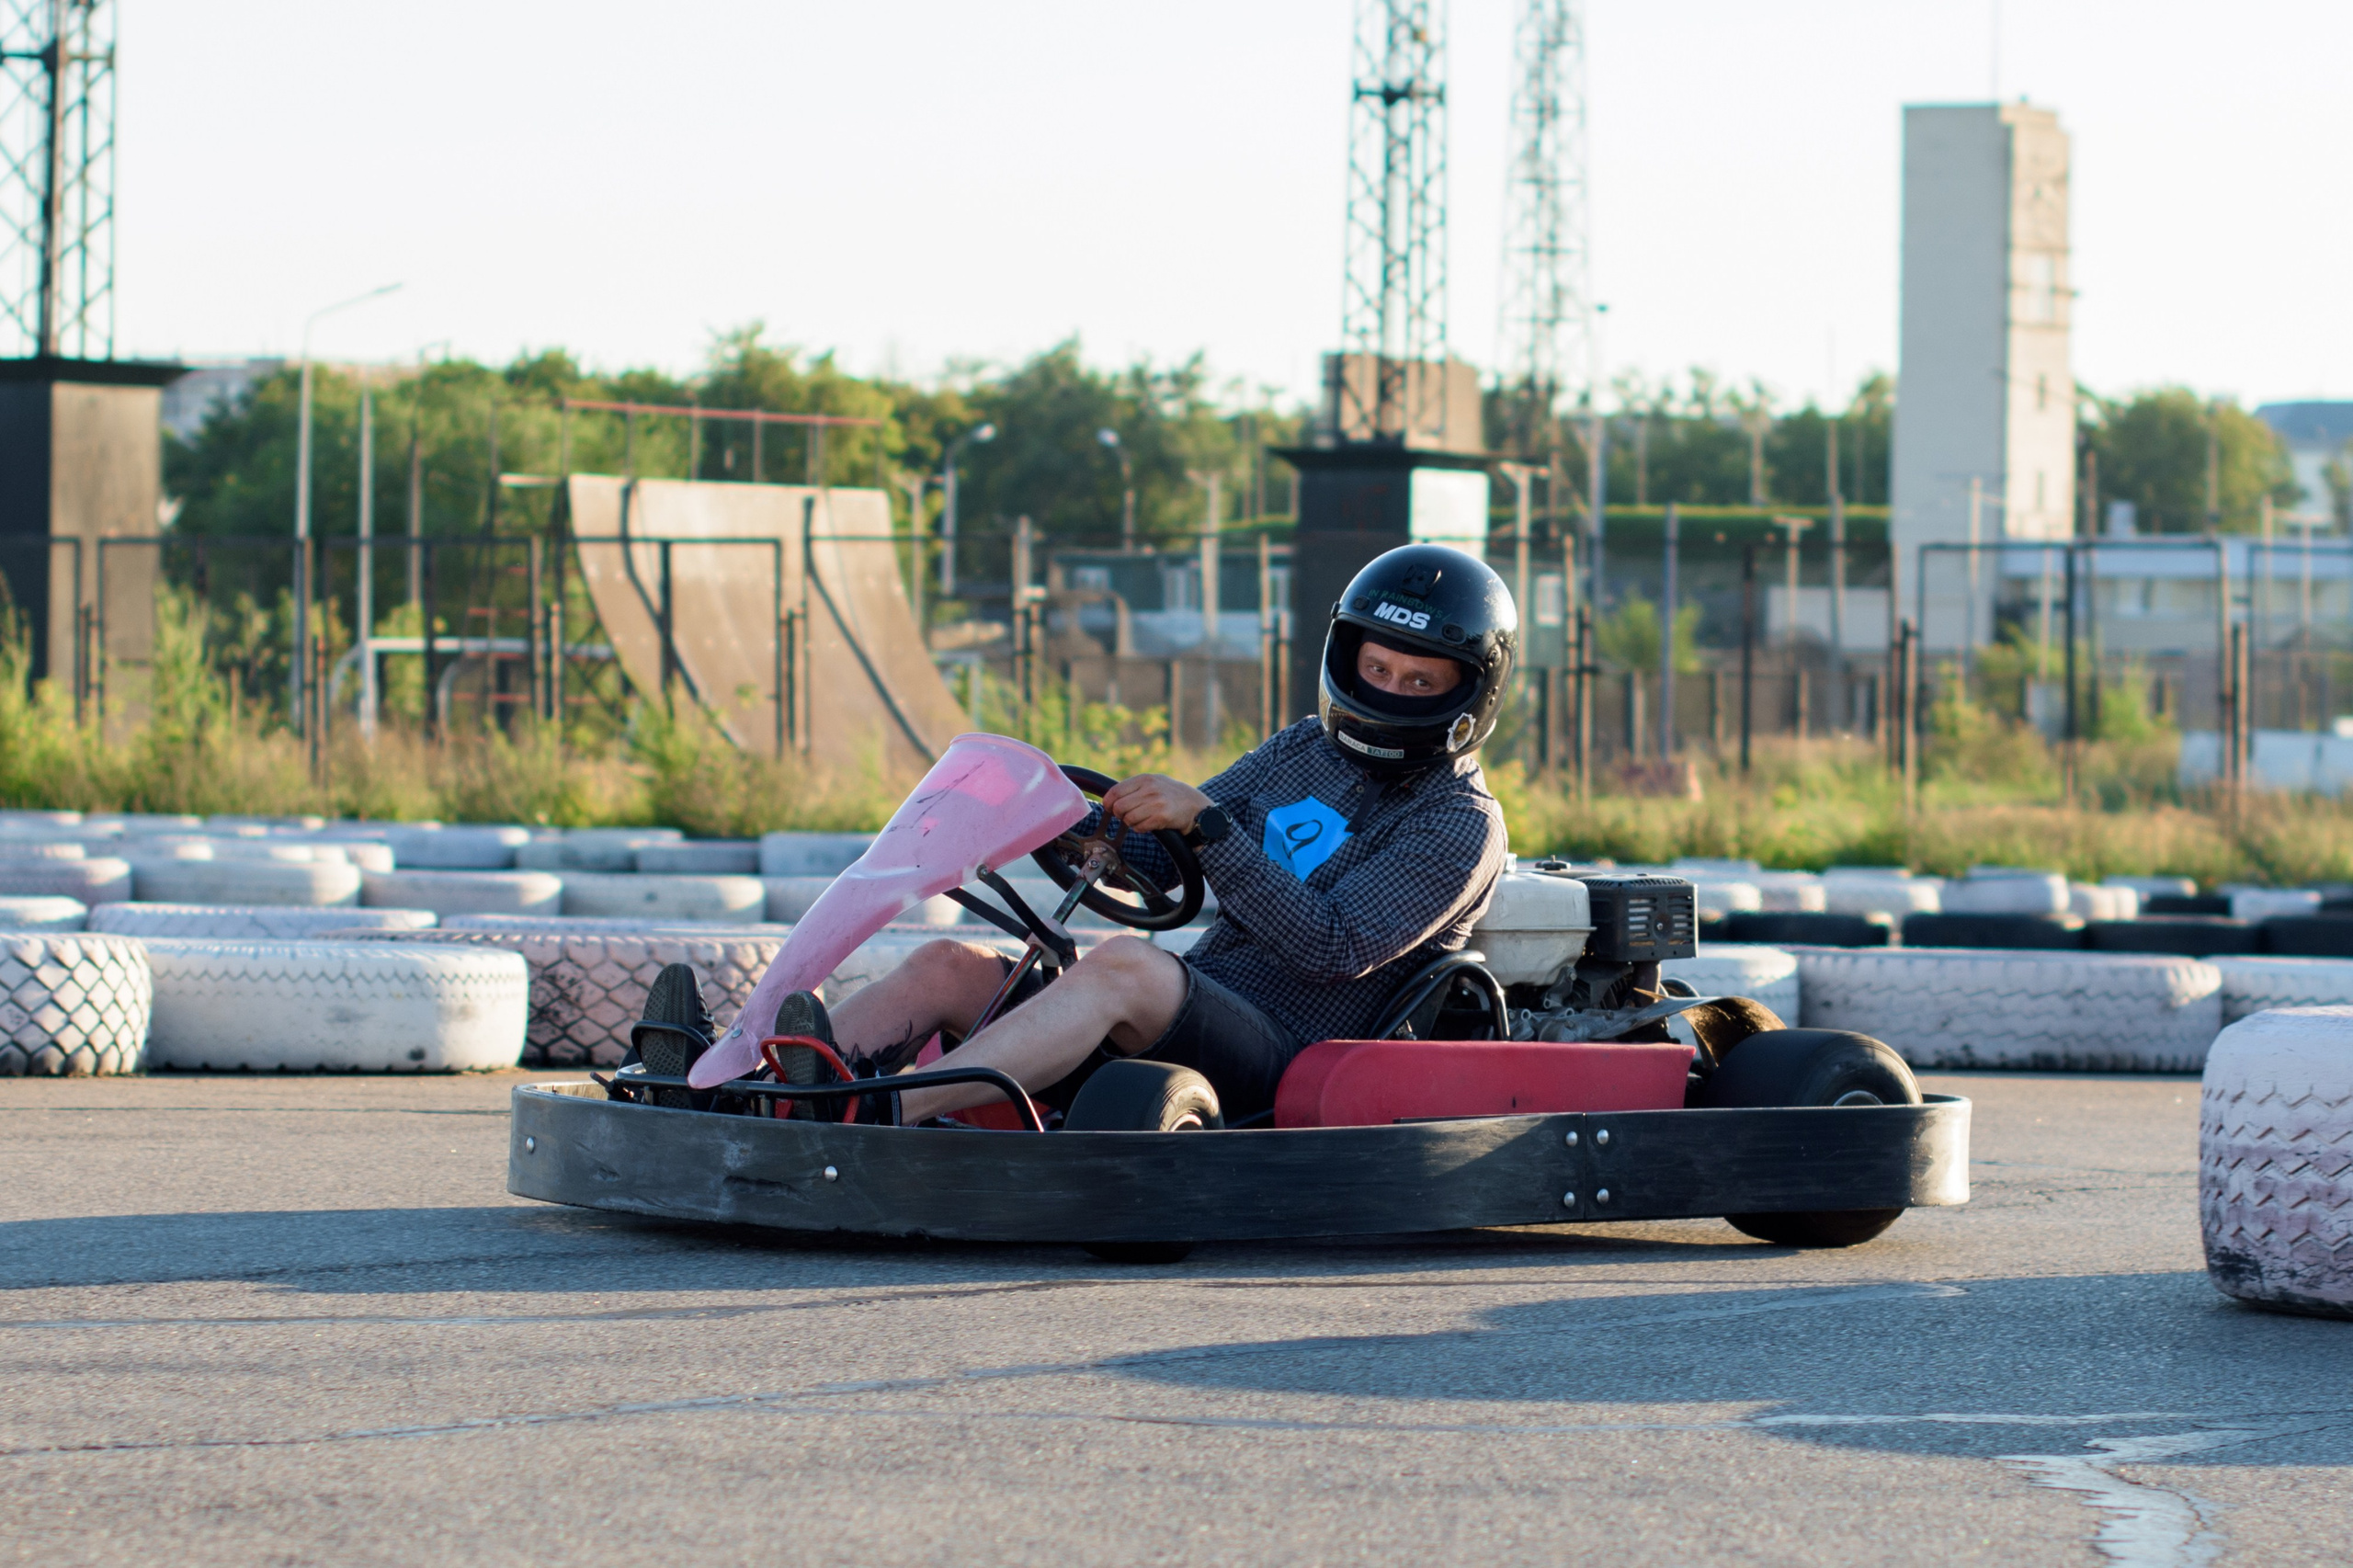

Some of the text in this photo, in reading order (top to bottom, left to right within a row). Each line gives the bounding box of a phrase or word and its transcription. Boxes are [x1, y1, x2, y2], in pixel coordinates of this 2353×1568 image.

[1368, 589, 1380, 597] IN
[1373, 601, 1431, 630] MDS
[1339, 733, 1402, 758] BARACA TATTOO
